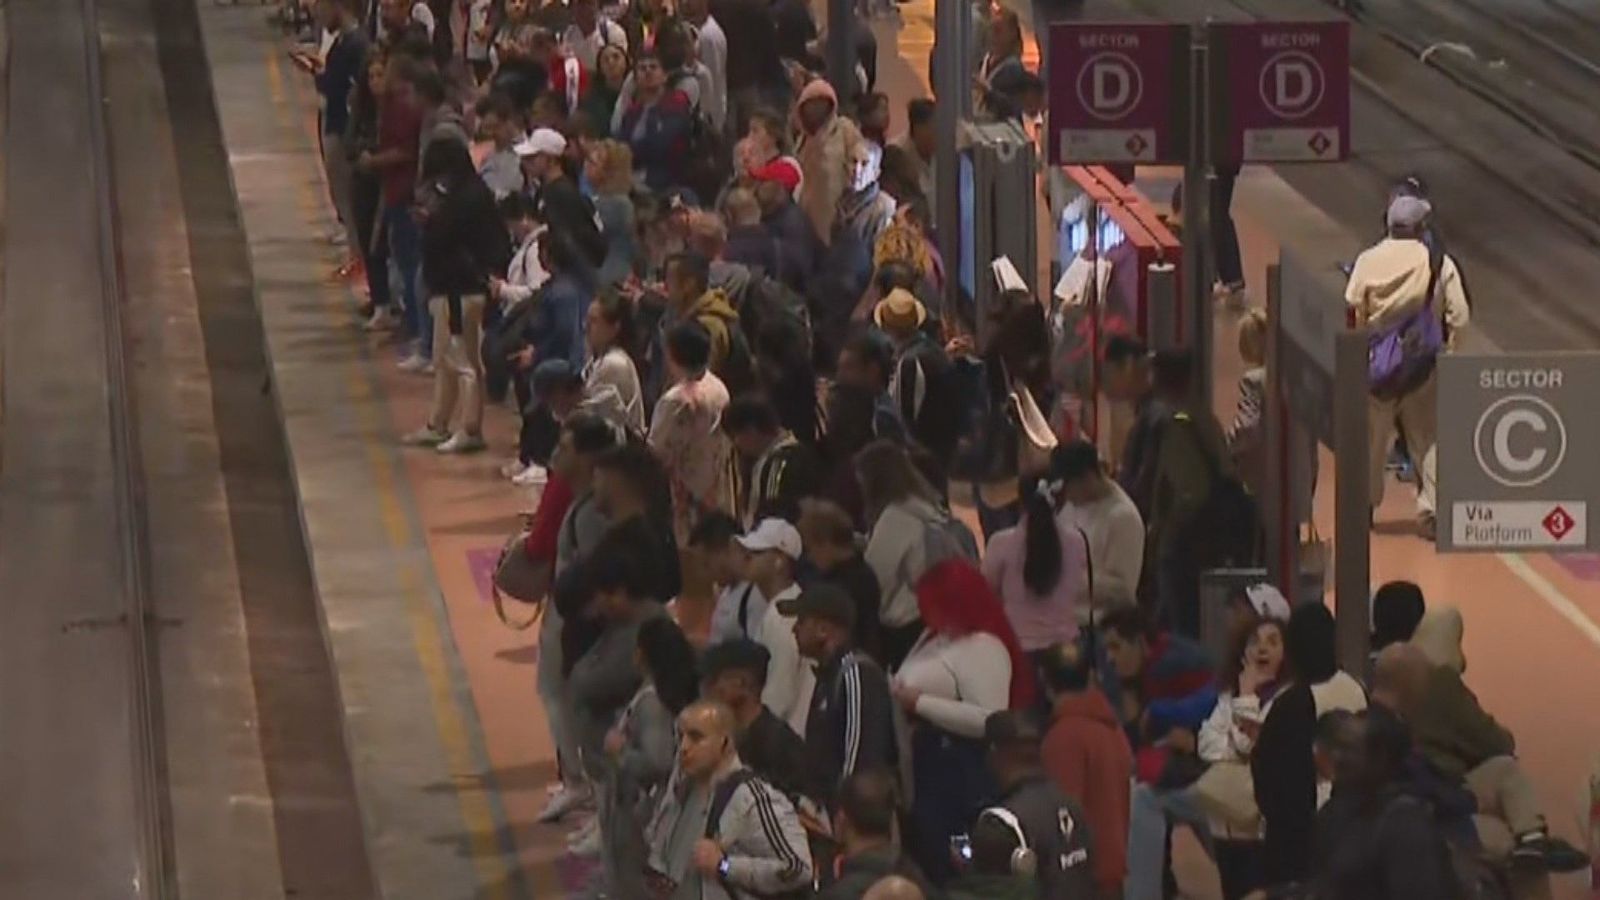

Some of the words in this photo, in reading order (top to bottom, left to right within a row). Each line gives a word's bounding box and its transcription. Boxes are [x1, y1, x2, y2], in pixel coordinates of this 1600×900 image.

[1094, 63, 1129, 108] D
[1276, 63, 1312, 106] D
[1480, 369, 1563, 388] SECTOR
[1494, 409, 1547, 472] C
[1465, 524, 1532, 542] Platform
